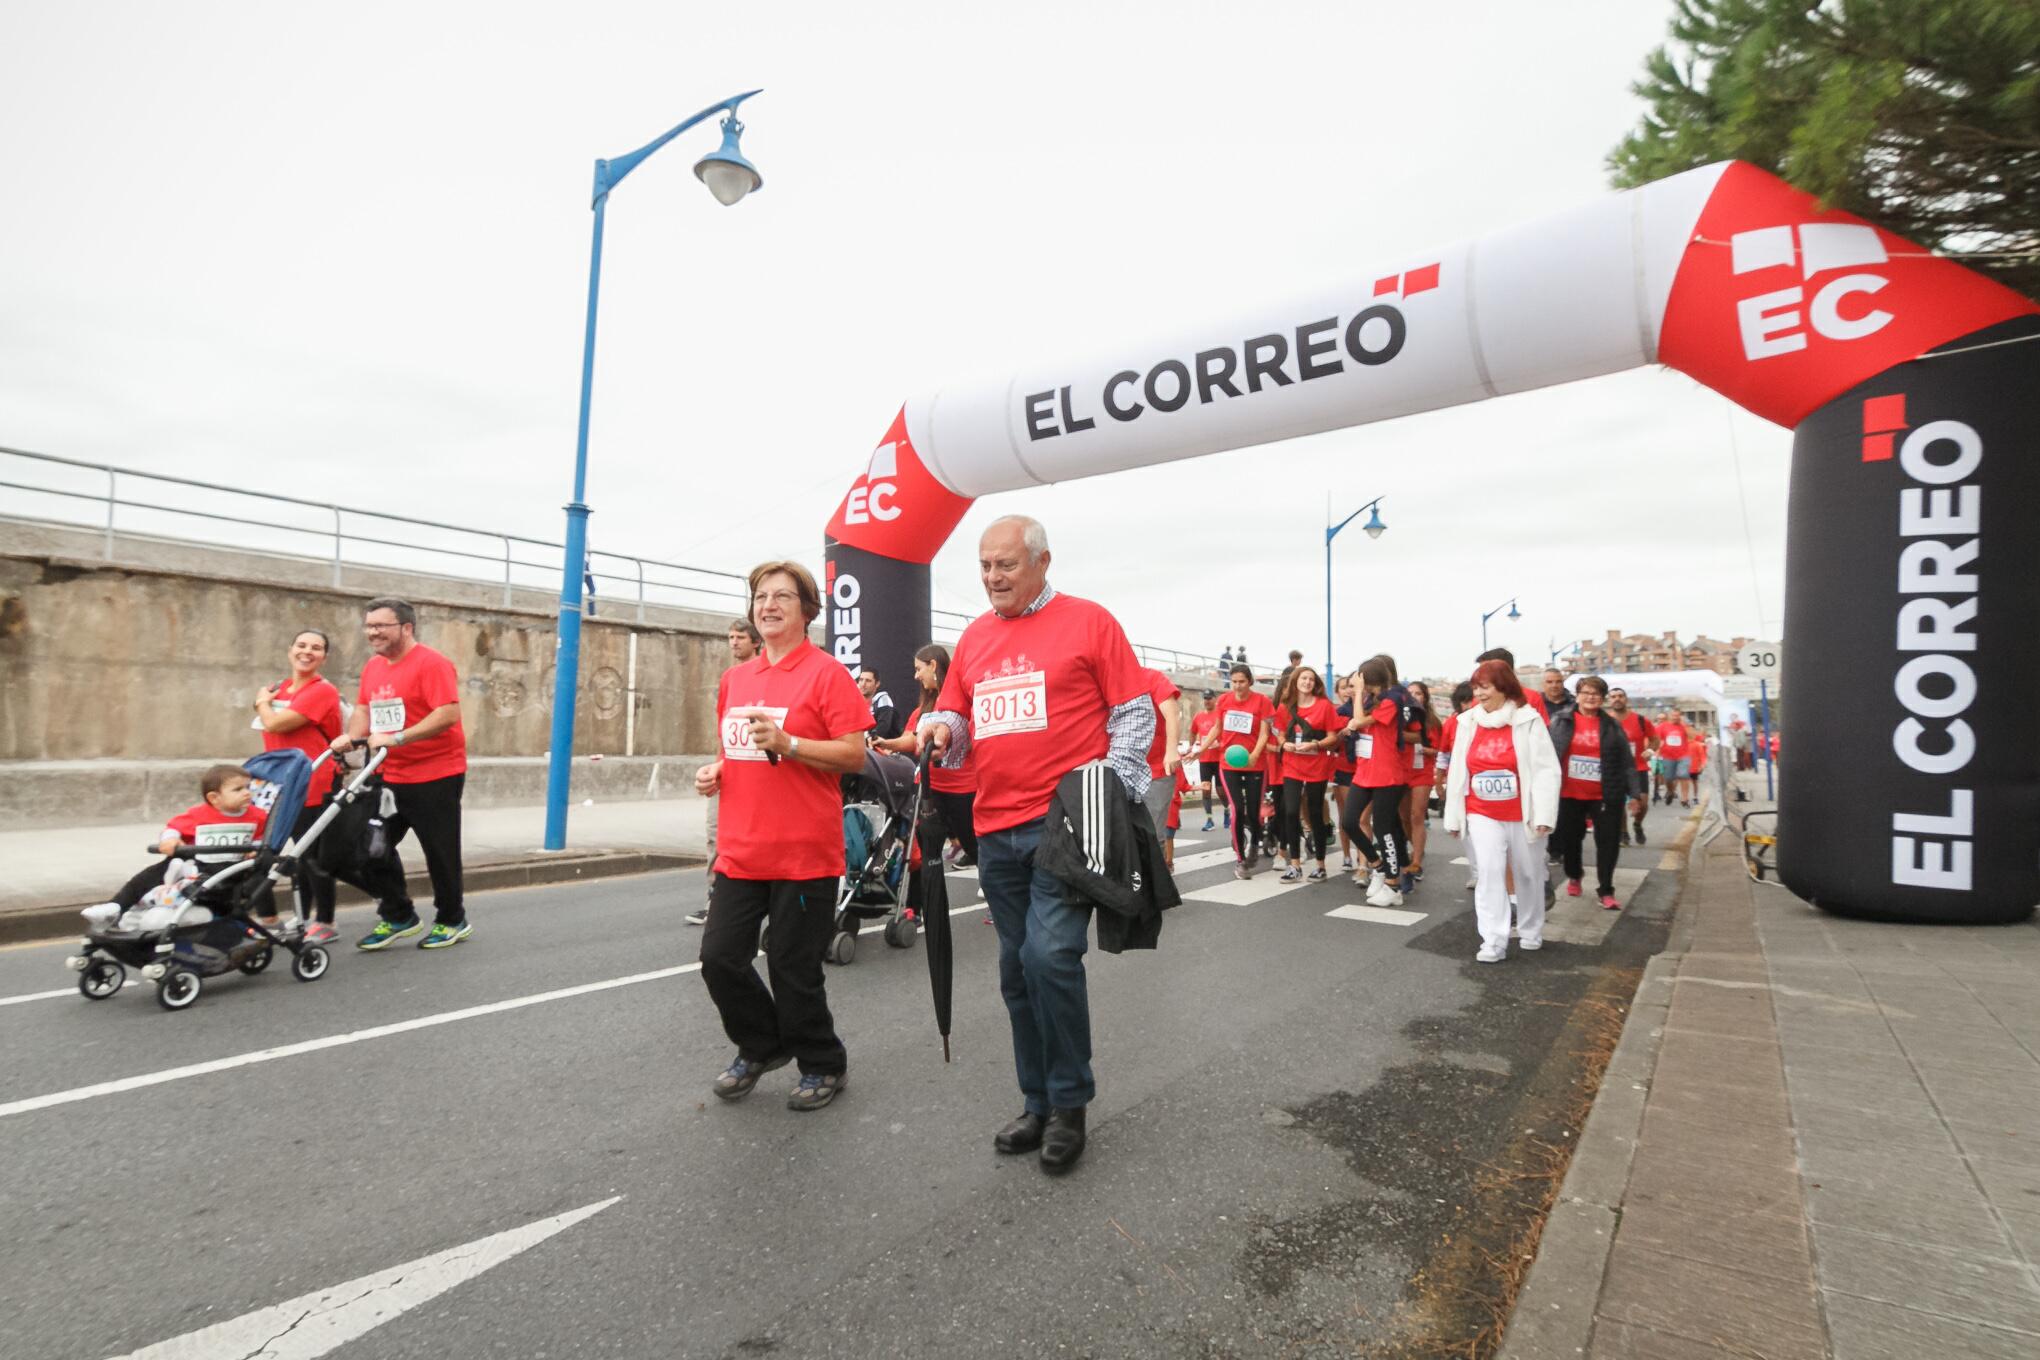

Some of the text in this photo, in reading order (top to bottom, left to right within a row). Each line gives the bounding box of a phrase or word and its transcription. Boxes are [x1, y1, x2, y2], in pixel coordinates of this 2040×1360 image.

[1736, 273, 1895, 361] EC
[1026, 304, 1407, 442] EL CORREO
[844, 482, 902, 526] EC
[833, 573, 862, 680] REO
[1750, 653, 1776, 668] 30
[1891, 420, 1983, 890] EL CORREO
[981, 691, 1037, 724] 3013
[728, 722, 750, 746] 30
[1478, 778, 1512, 793] 1004
[1382, 833, 1398, 875] adidas
